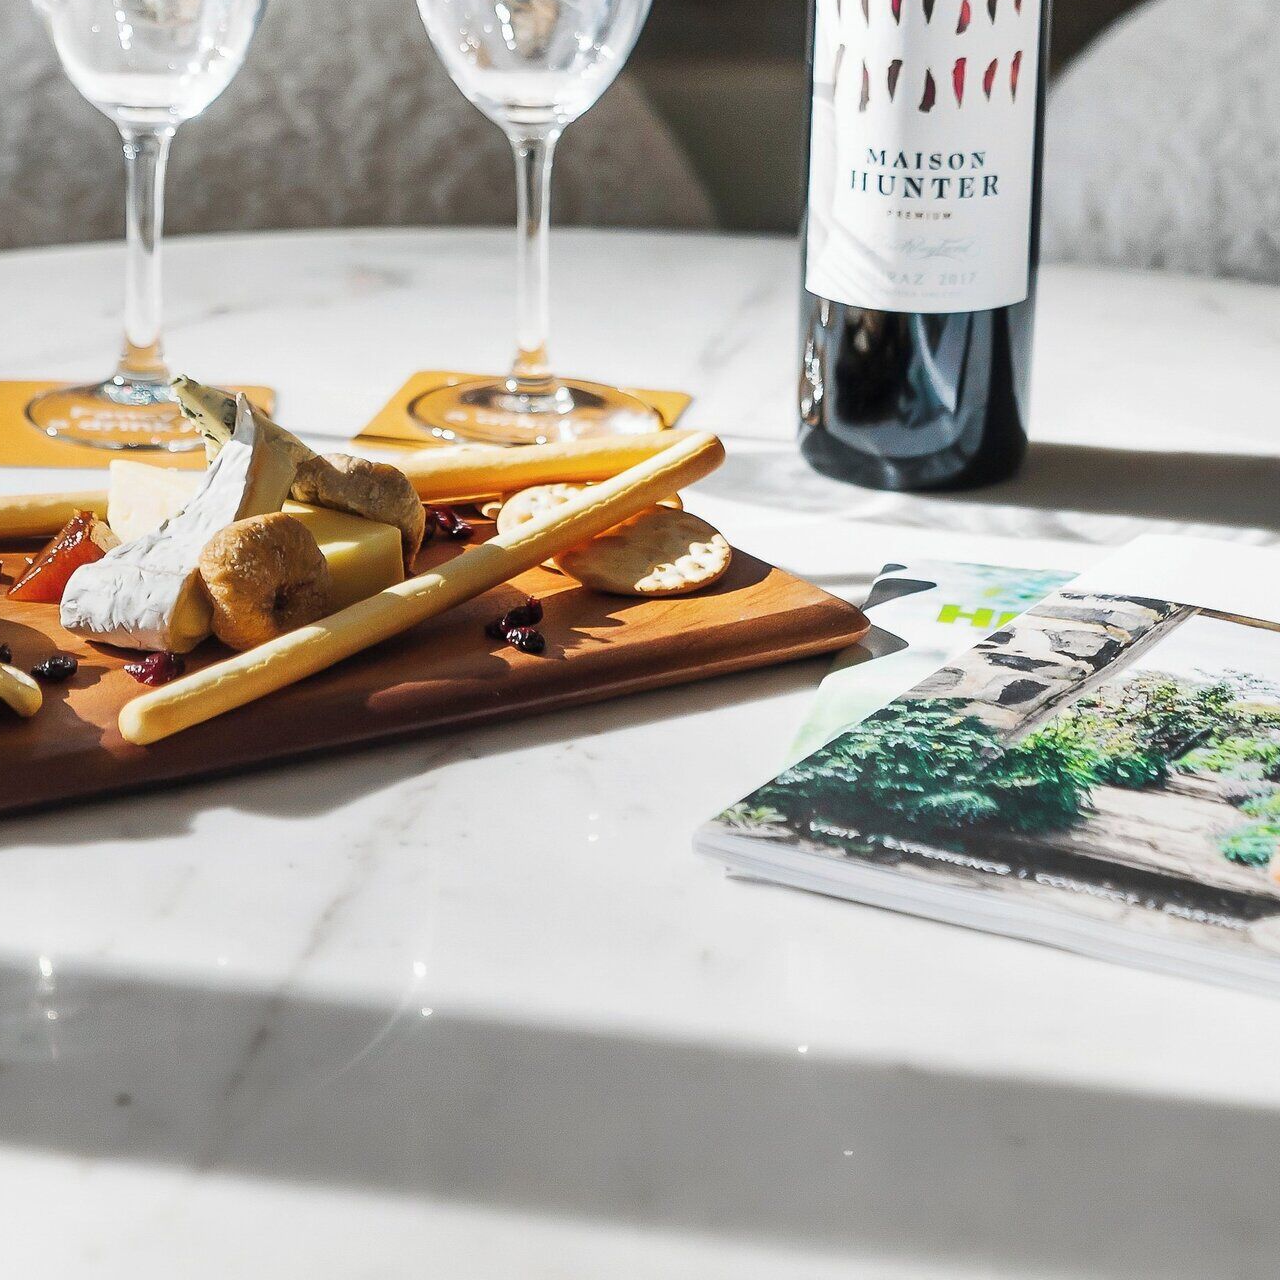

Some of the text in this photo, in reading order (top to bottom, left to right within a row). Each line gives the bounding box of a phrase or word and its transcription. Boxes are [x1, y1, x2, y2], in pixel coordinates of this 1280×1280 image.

[867, 147, 986, 171] MAISON
[851, 170, 1000, 200] HUNTER
[880, 835, 1011, 875] EXPERIENCE
